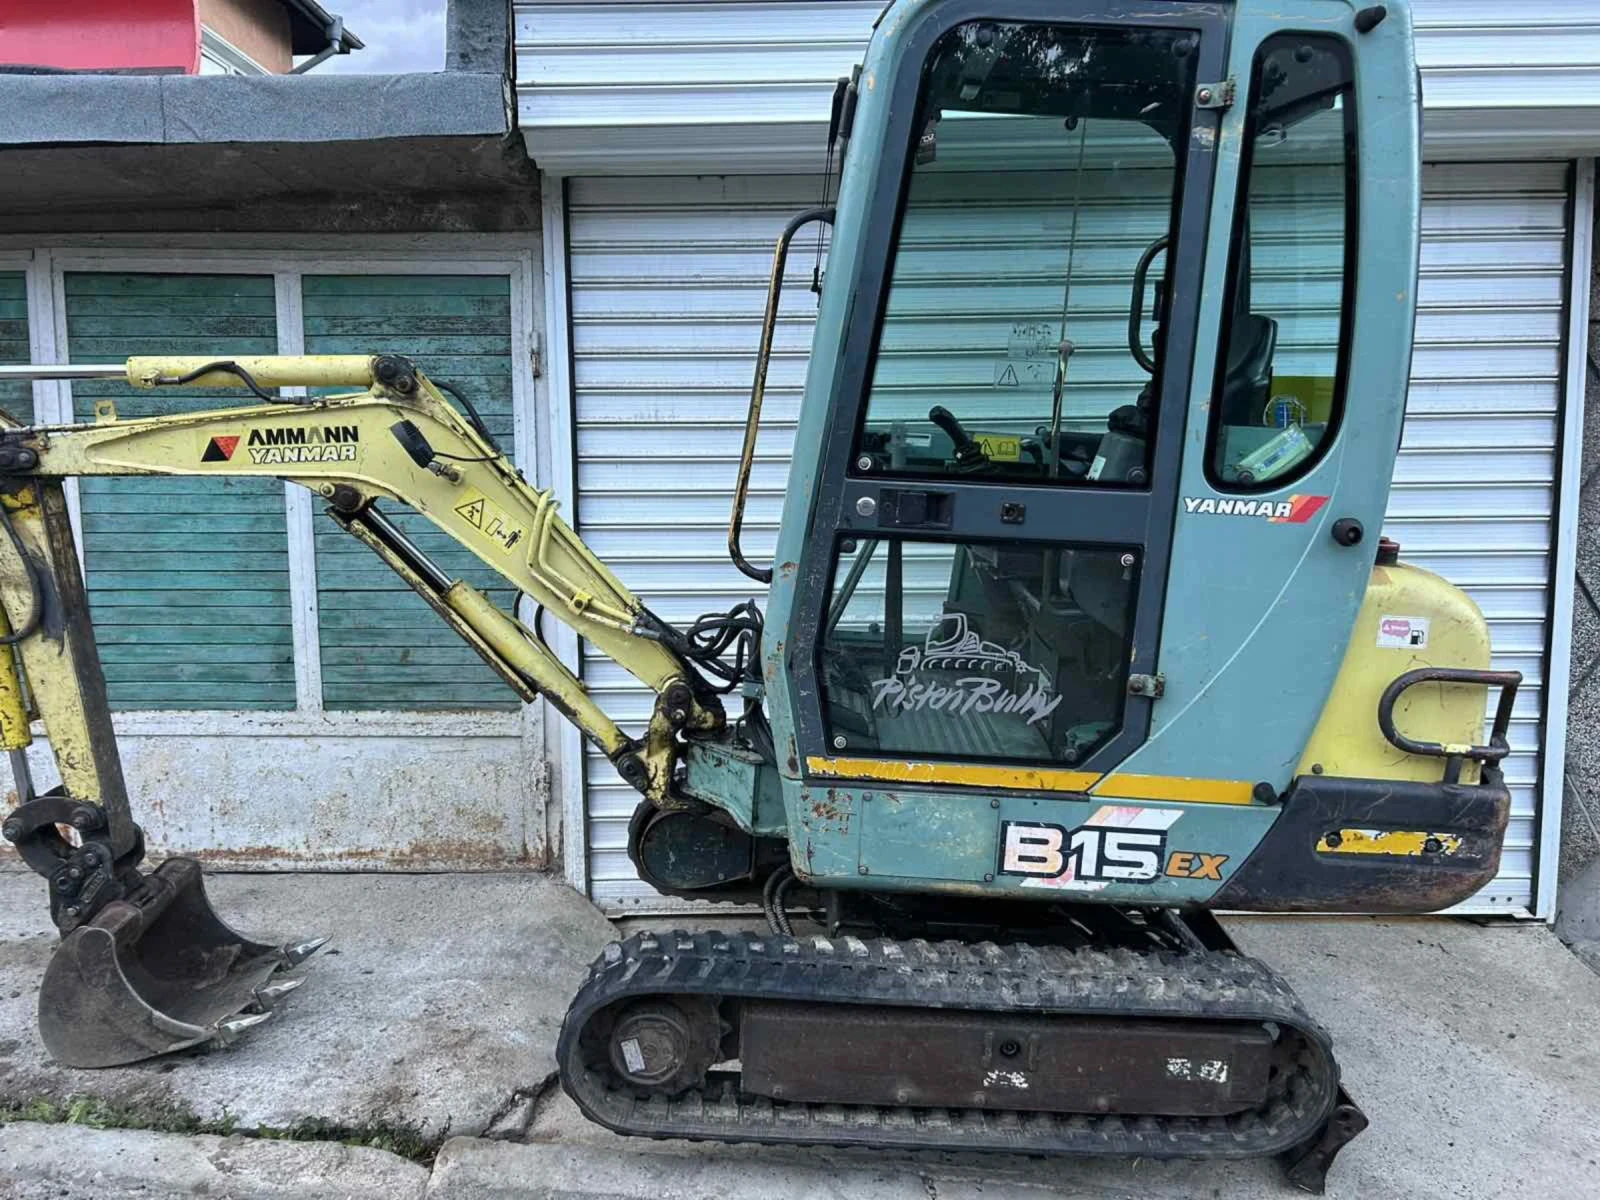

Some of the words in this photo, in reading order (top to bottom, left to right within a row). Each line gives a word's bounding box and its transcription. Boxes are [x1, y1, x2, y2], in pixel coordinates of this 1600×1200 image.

[248, 426, 359, 446] AMMANN
[248, 445, 357, 464] YANMAR
[1184, 497, 1293, 518] YANMAR
[999, 821, 1168, 883] B15
[1164, 851, 1230, 881] EX
